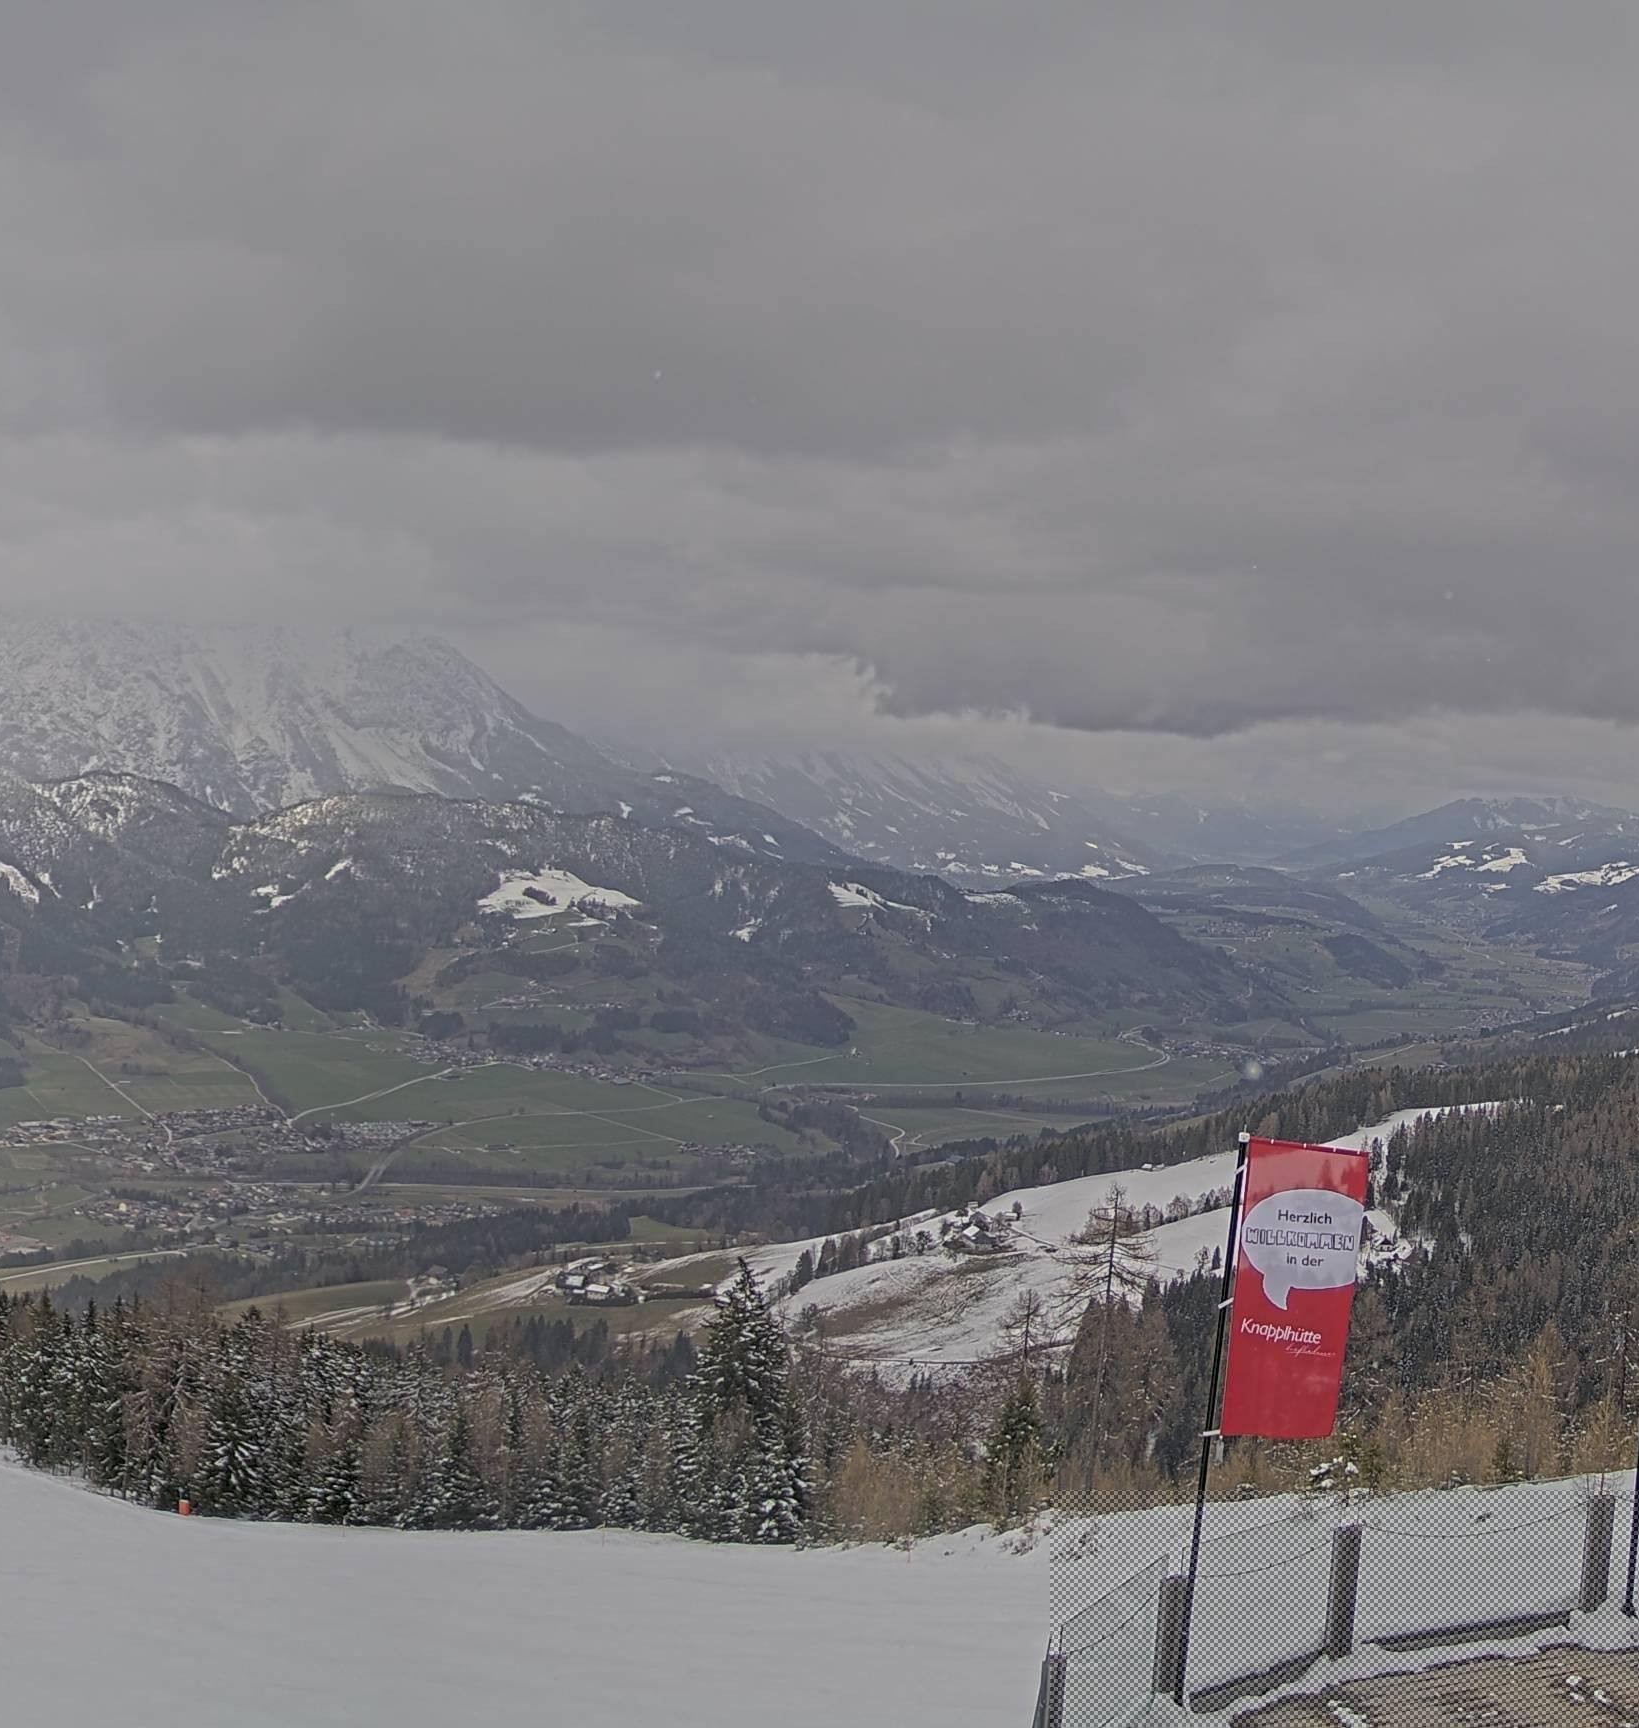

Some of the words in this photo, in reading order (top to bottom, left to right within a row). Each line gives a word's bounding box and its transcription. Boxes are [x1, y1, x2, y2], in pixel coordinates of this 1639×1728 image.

[1277, 1209, 1332, 1225] Herzlich
[1245, 1226, 1355, 1252] WILLKOMMEN
[1286, 1252, 1297, 1265] in
[1301, 1254, 1324, 1267] der
[1240, 1317, 1322, 1345] Knapplhütte
